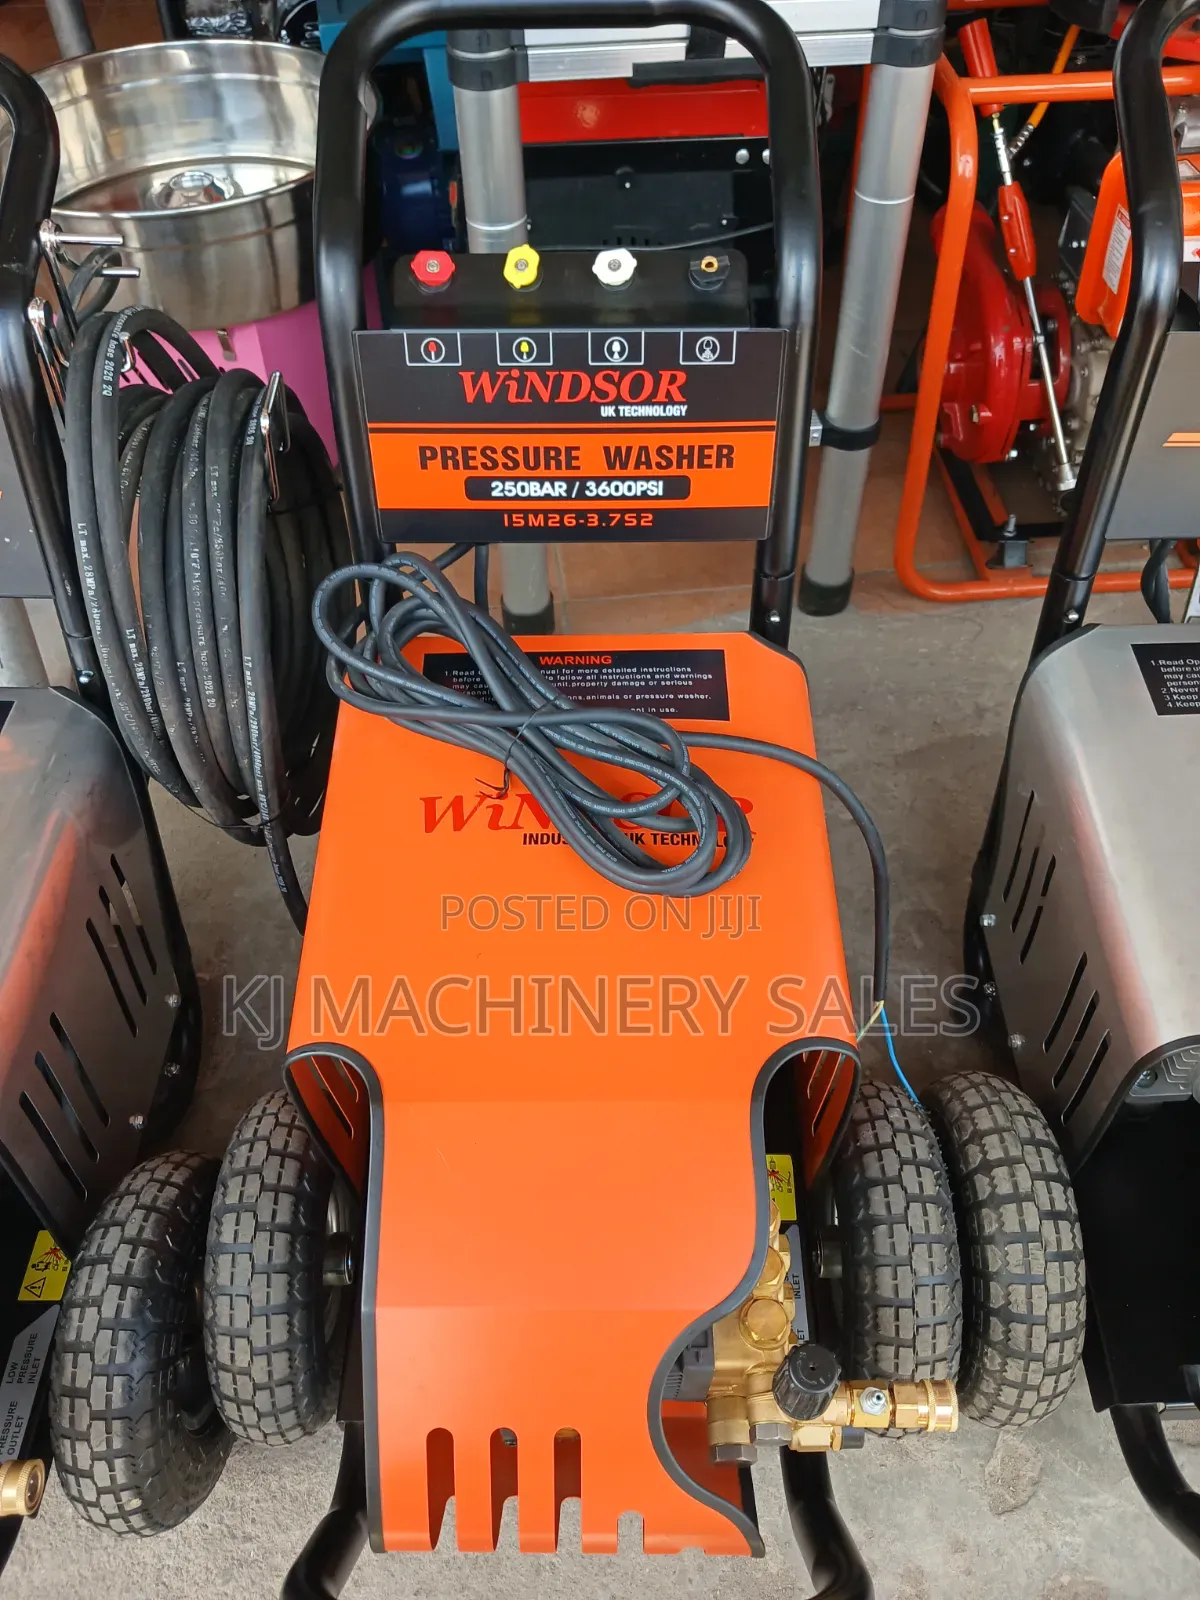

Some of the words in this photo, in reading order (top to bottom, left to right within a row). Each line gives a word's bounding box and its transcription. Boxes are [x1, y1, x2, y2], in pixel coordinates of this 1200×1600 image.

[106, 339, 119, 358] hose
[103, 359, 115, 382] 2026
[102, 383, 113, 397] 2Q
[600, 405, 616, 417] UK
[618, 404, 688, 416] TECHNOLOGY
[418, 445, 581, 471] PRESSURE
[603, 444, 735, 470] WASHER
[490, 481, 567, 497] 250BAR
[571, 481, 580, 499] /
[584, 480, 664, 497] 3600PSI
[77, 522, 88, 536] LT
[126, 628, 137, 640] LT
[244, 656, 252, 668] LT
[539, 655, 612, 665] WARNING
[792, 1273, 802, 1300] INLET
[16, 1332, 39, 1384] PRESSURE
[6, 1361, 19, 1384] LOW
[27, 1356, 41, 1384] INLET
[0, 1400, 18, 1456] RESSURE
[7, 1415, 25, 1456] OUTLET
